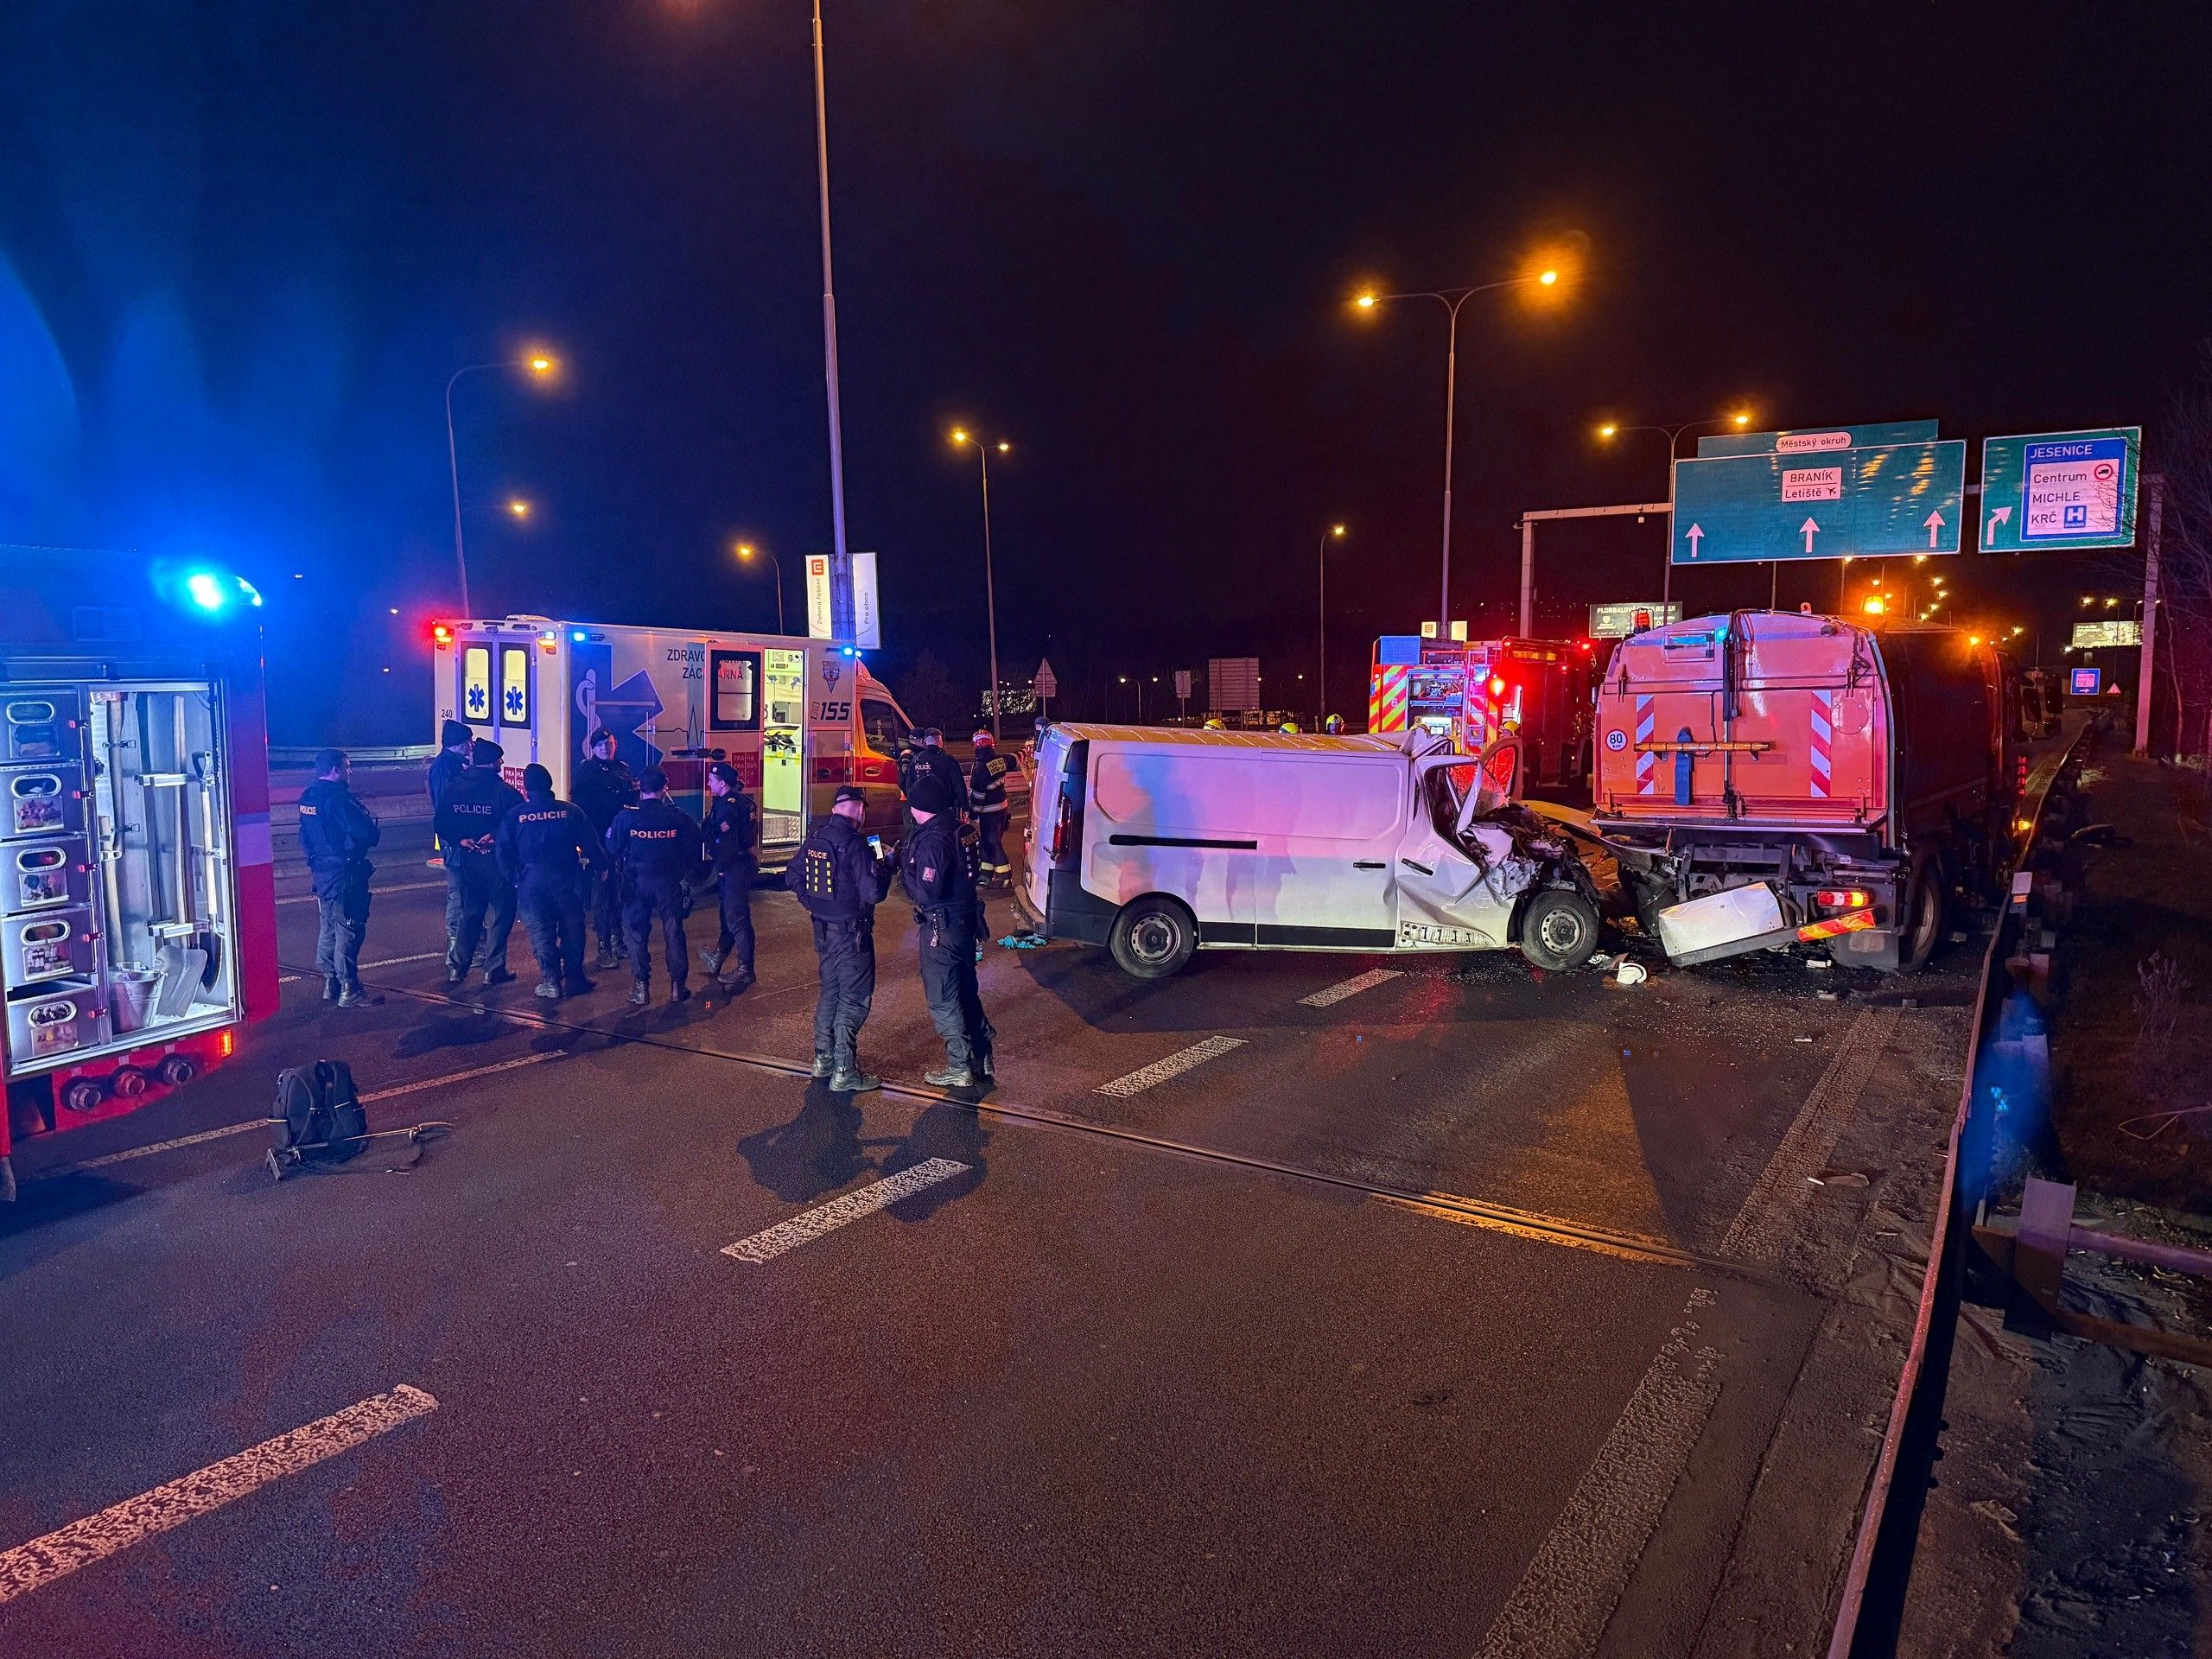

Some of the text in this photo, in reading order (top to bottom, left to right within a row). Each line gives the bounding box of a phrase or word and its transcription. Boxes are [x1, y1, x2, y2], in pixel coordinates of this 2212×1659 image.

[1781, 435, 1847, 448] Městský okruh
[2031, 445, 2092, 458] JESENICE
[1790, 470, 1833, 482] BRANÍK
[2033, 473, 2088, 484] Centrum
[1785, 487, 1822, 499] Letiště
[2032, 491, 2081, 504] MICHLE
[2031, 512, 2057, 524] KRČ
[442, 709, 453, 718] 240
[820, 702, 851, 721] 155
[1610, 734, 1623, 744] 80
[453, 804, 493, 815] POLICIE
[518, 810, 568, 823] POLICIE
[630, 830, 677, 839] POLICIE
[808, 849, 828, 860] POLICIE
